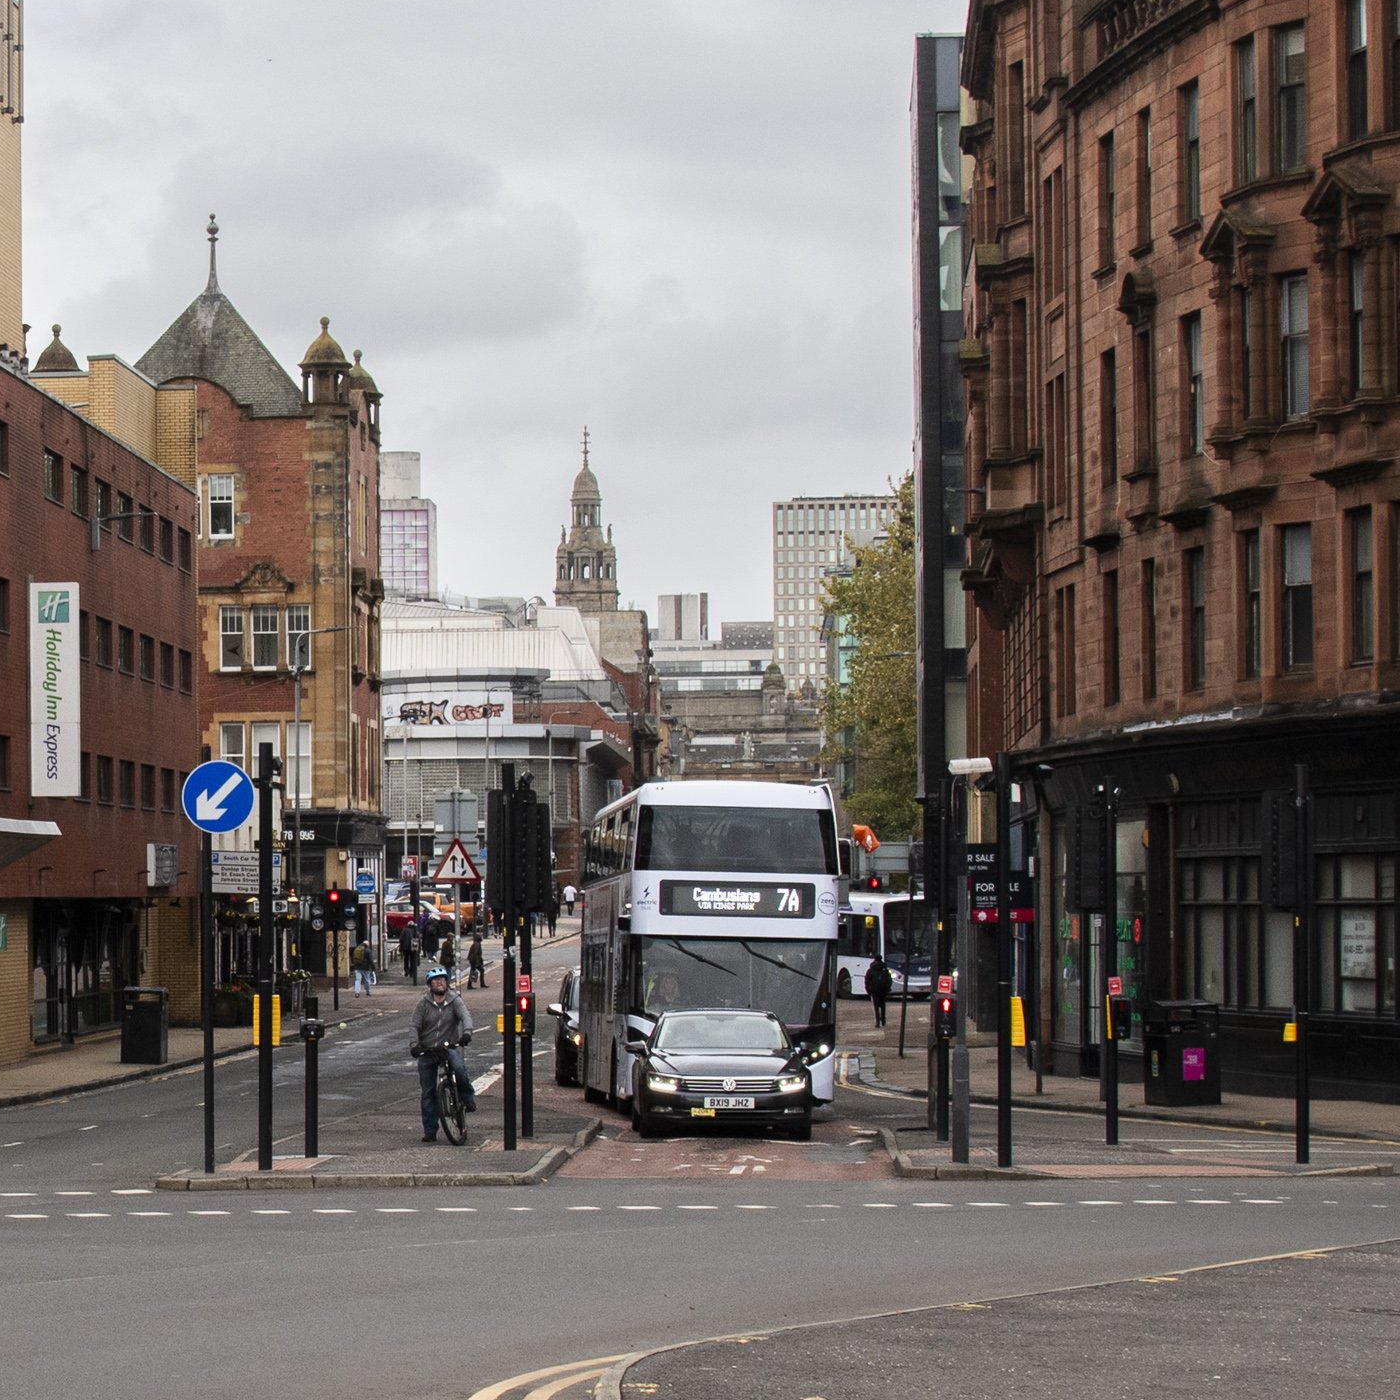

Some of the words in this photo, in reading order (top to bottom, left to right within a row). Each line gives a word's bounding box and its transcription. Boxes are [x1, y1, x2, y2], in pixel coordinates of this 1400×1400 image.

[42, 628, 62, 693] Holiday
[46, 693, 62, 721] Inn
[43, 724, 61, 780] Express
[975, 853, 995, 862] SALE
[975, 883, 995, 892] FOR
[692, 887, 761, 903] Cambuslang
[776, 888, 800, 912] 7A
[820, 898, 835, 906] zero
[698, 902, 712, 910] VIA
[713, 902, 736, 910] KINGS
[736, 902, 755, 910] PARK
[709, 1098, 730, 1107] BX19
[731, 1098, 749, 1107] JHZ
